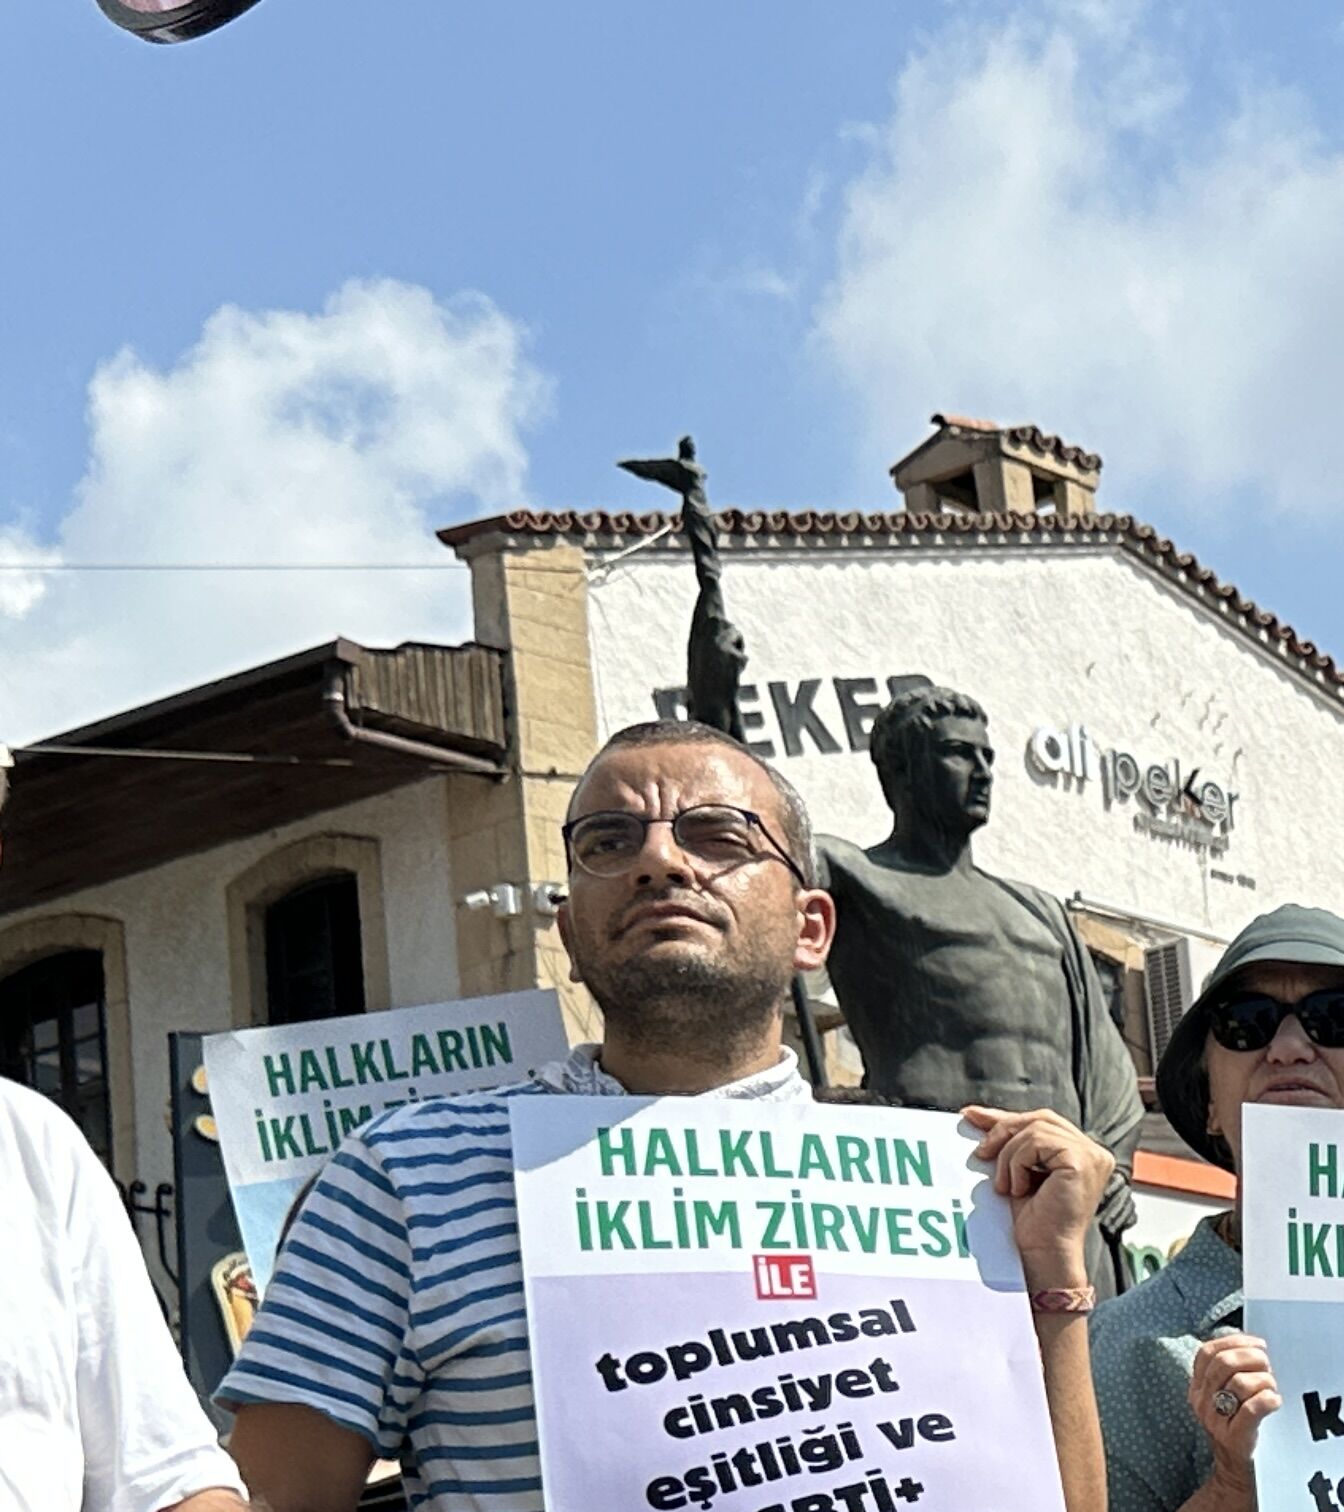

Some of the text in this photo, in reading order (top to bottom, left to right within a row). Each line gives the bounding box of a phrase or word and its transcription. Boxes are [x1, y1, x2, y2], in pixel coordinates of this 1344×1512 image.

[263, 1021, 513, 1098] HALKLARIN
[596, 1126, 933, 1187] HALKLARIN
[575, 1187, 972, 1260] İKLİM ZİRVESİ
[757, 1256, 815, 1297] İLE
[595, 1299, 917, 1393] toplumsal
[663, 1356, 900, 1440] cinsiyet
[645, 1411, 957, 1511] eşitliği ve
